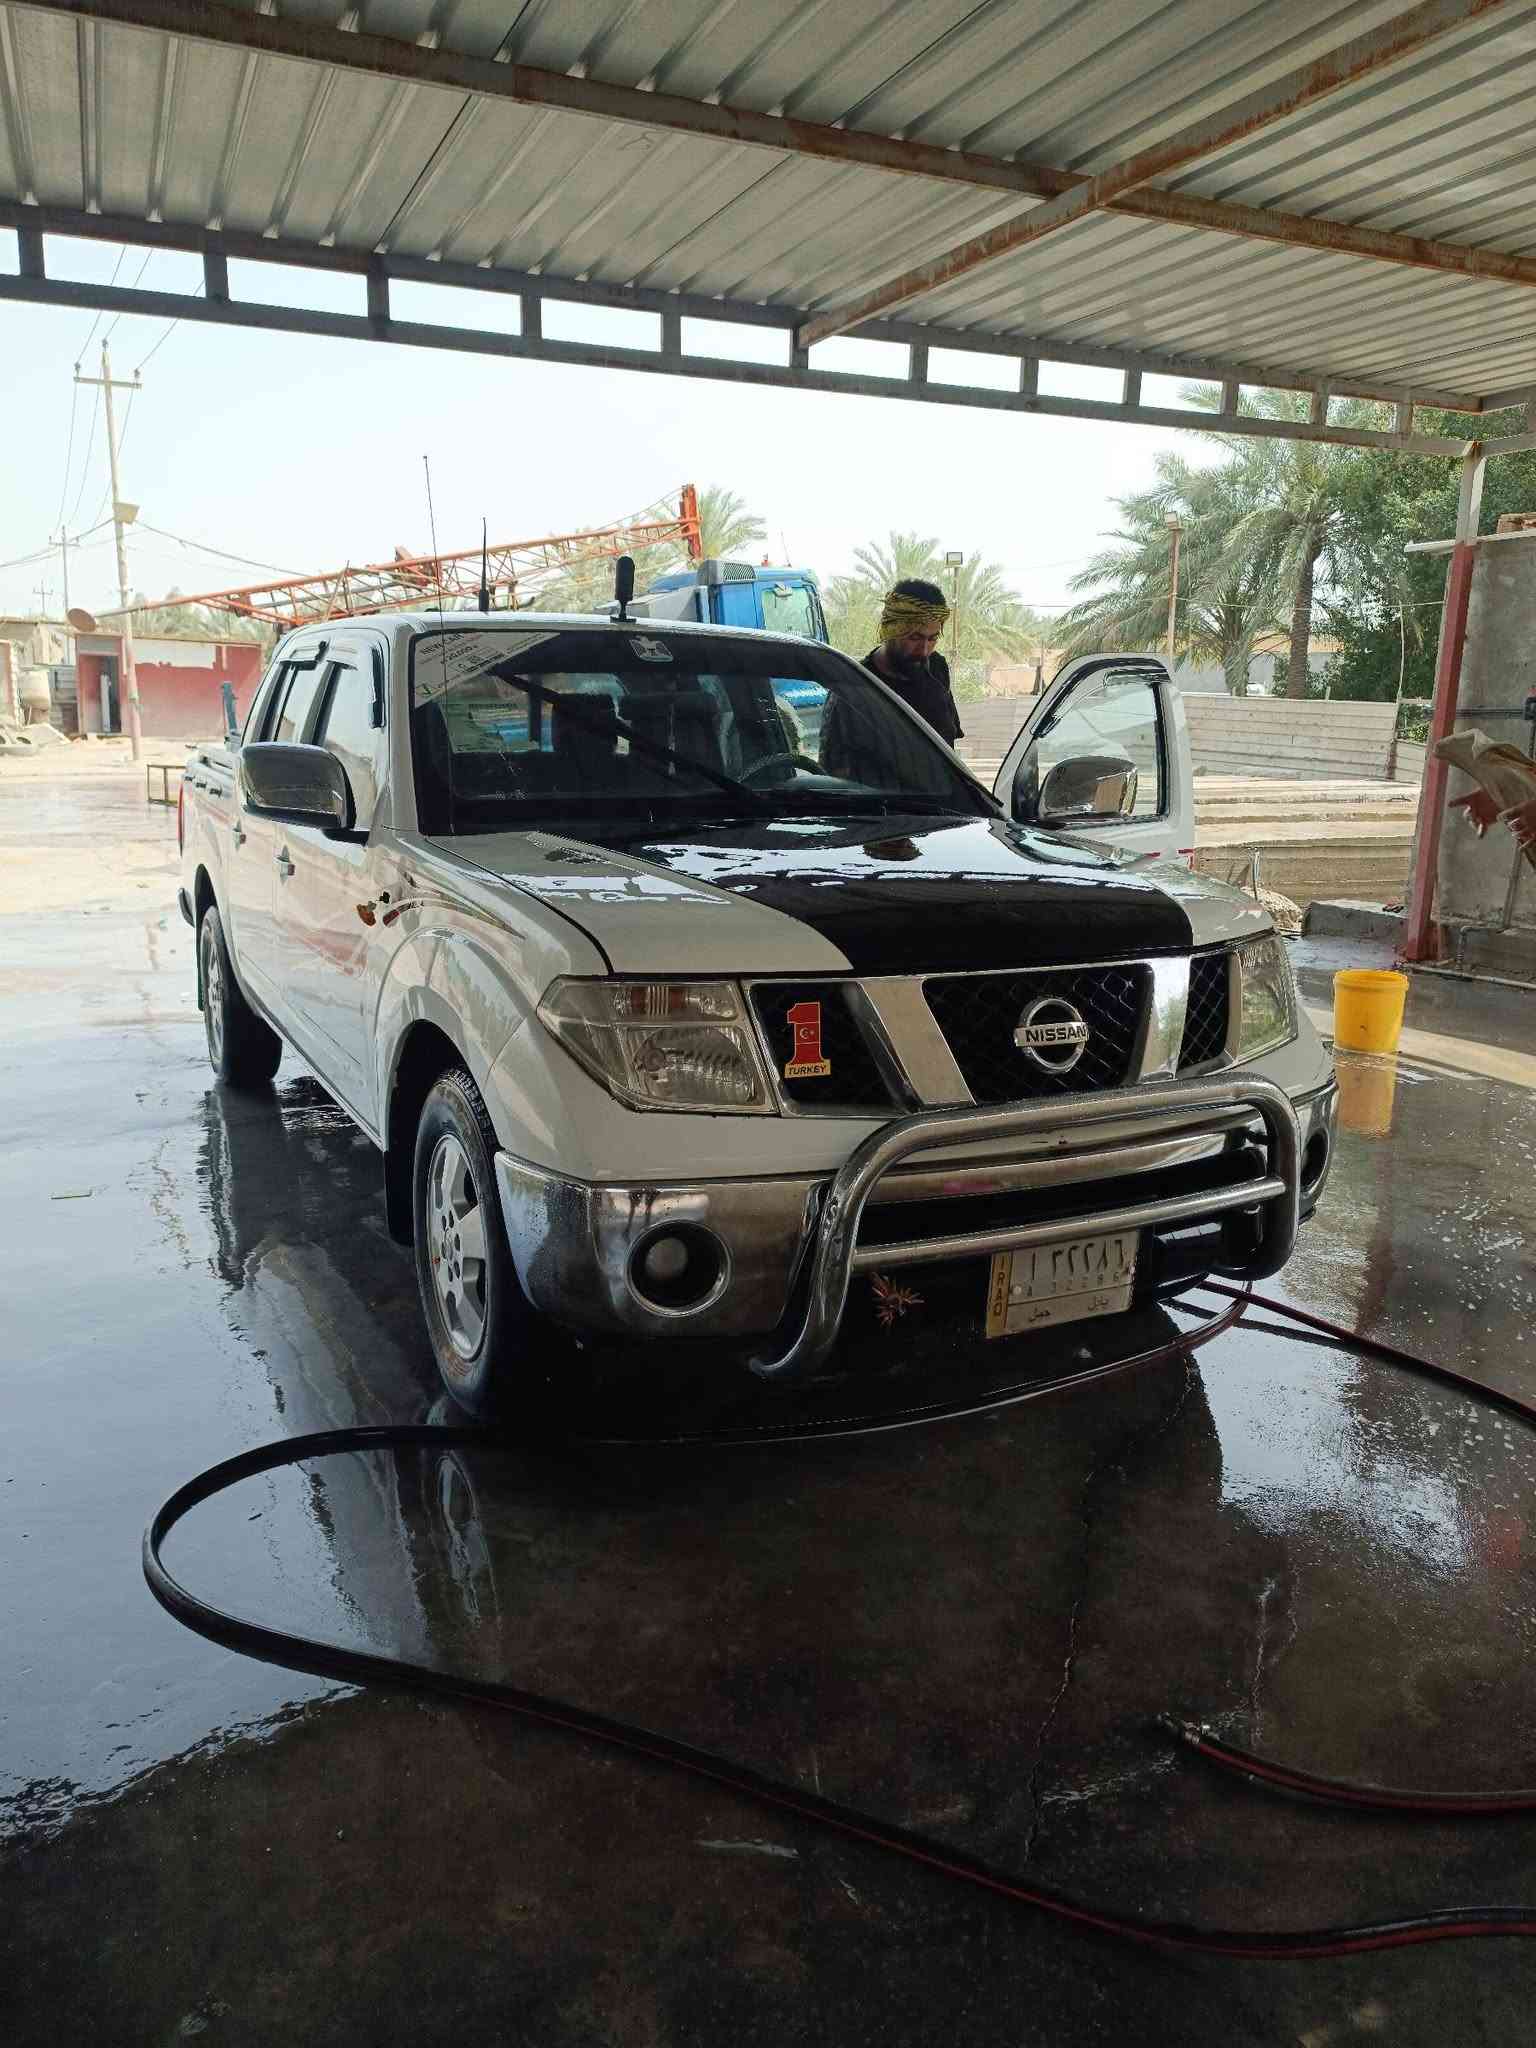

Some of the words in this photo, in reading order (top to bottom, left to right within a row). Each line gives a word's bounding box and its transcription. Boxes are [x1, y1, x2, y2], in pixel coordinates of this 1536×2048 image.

[1025, 1025, 1086, 1042] NISSAN
[789, 1063, 826, 1075] TURKEY
[993, 1254, 1006, 1316] IRAQ
